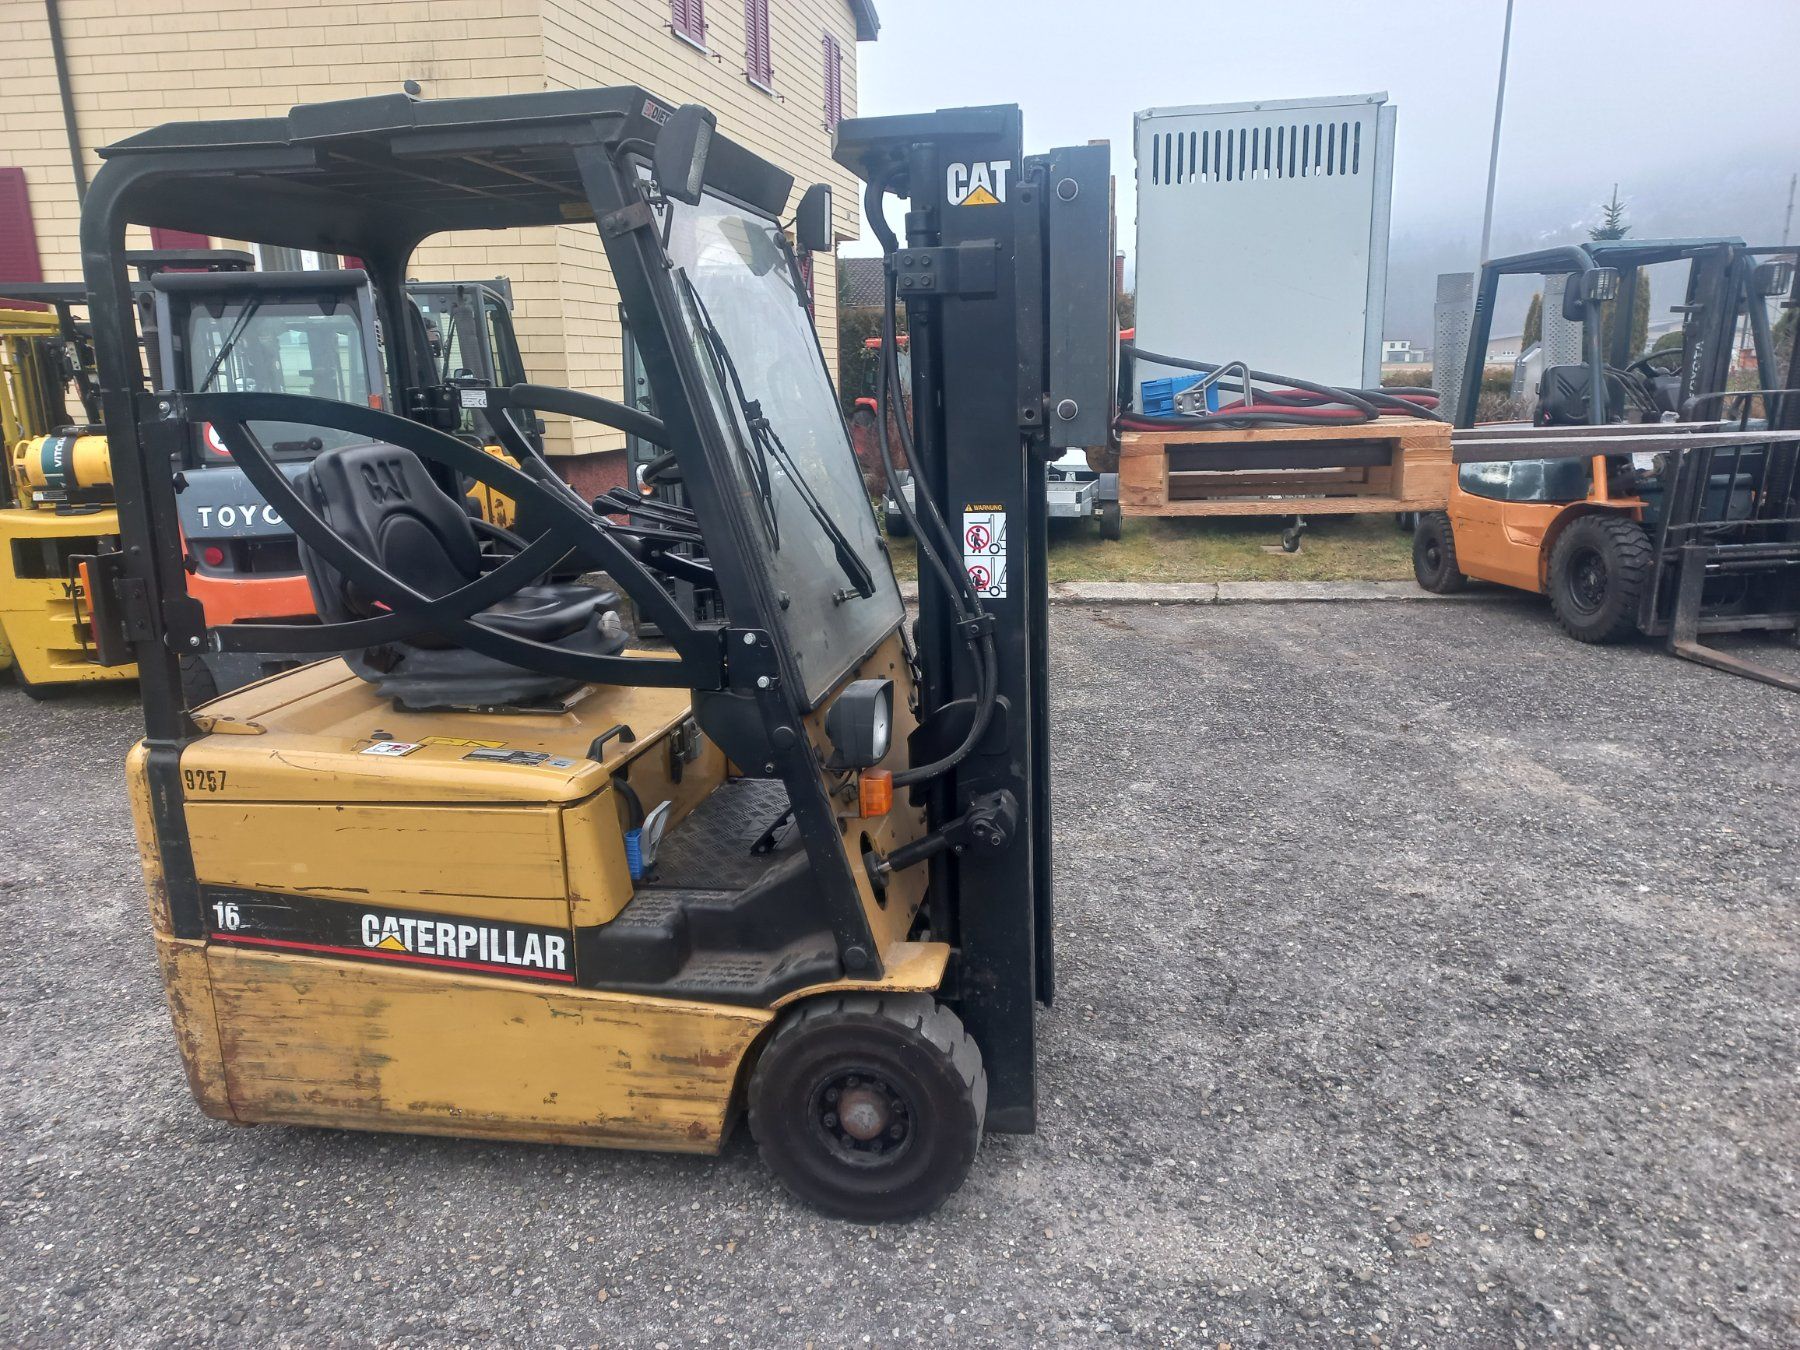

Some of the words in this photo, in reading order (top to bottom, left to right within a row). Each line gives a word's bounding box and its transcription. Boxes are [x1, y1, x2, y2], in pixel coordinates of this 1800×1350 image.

[946, 160, 1011, 206] CAT
[360, 459, 412, 504] CAT
[184, 769, 227, 793] 9257
[212, 901, 241, 931] 16
[361, 913, 567, 971] CATERPILLAR
